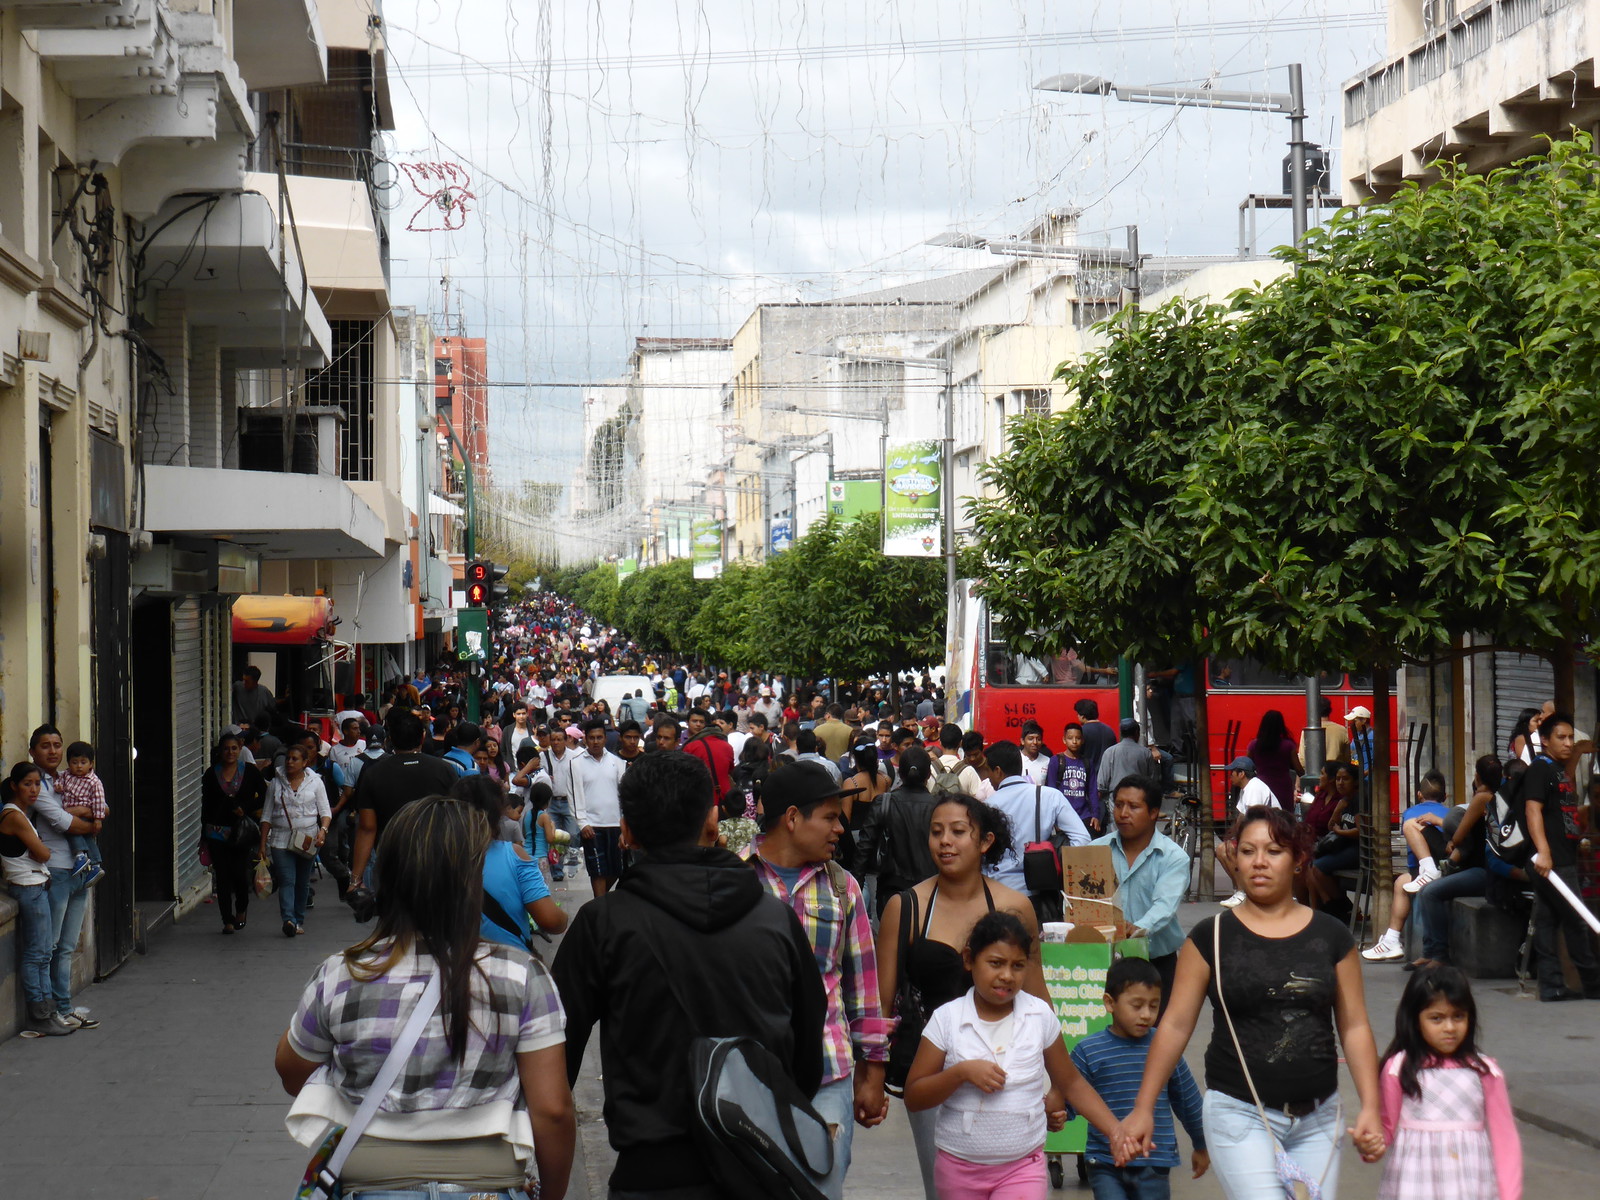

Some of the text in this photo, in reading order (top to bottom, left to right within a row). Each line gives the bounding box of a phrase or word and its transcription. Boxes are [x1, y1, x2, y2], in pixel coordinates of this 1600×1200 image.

[476, 566, 483, 578] 9
[1022, 703, 1036, 715] 65
[1072, 966, 1087, 981] de
